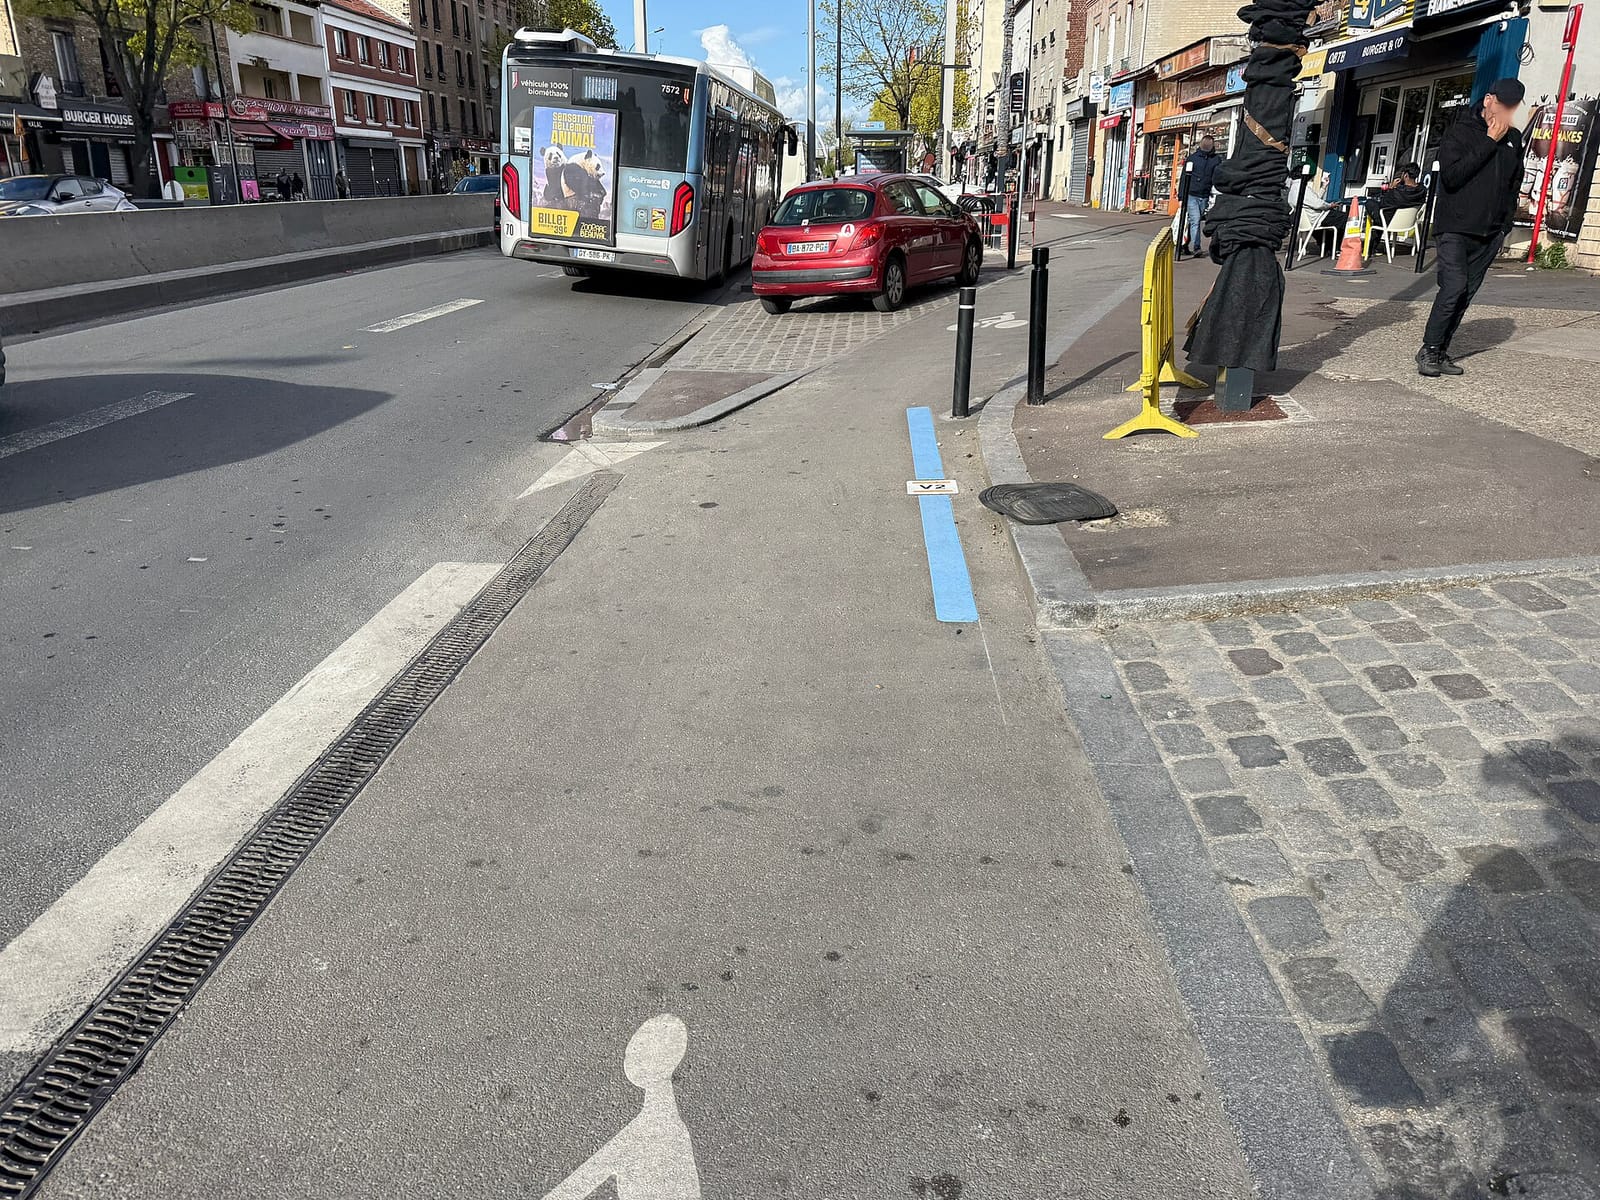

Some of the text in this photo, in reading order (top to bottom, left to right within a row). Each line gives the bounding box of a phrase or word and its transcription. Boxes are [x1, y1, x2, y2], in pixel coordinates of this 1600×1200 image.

[1362, 42, 1388, 58] BURGER
[1387, 41, 1394, 51] &
[521, 80, 569, 90] véhicule 100%
[661, 84, 680, 95] 7572
[528, 88, 569, 98] biométhane
[64, 110, 102, 124] BURGER
[104, 113, 135, 126] HOUSE
[551, 130, 597, 149] ANIMAL
[505, 223, 514, 236] 70
